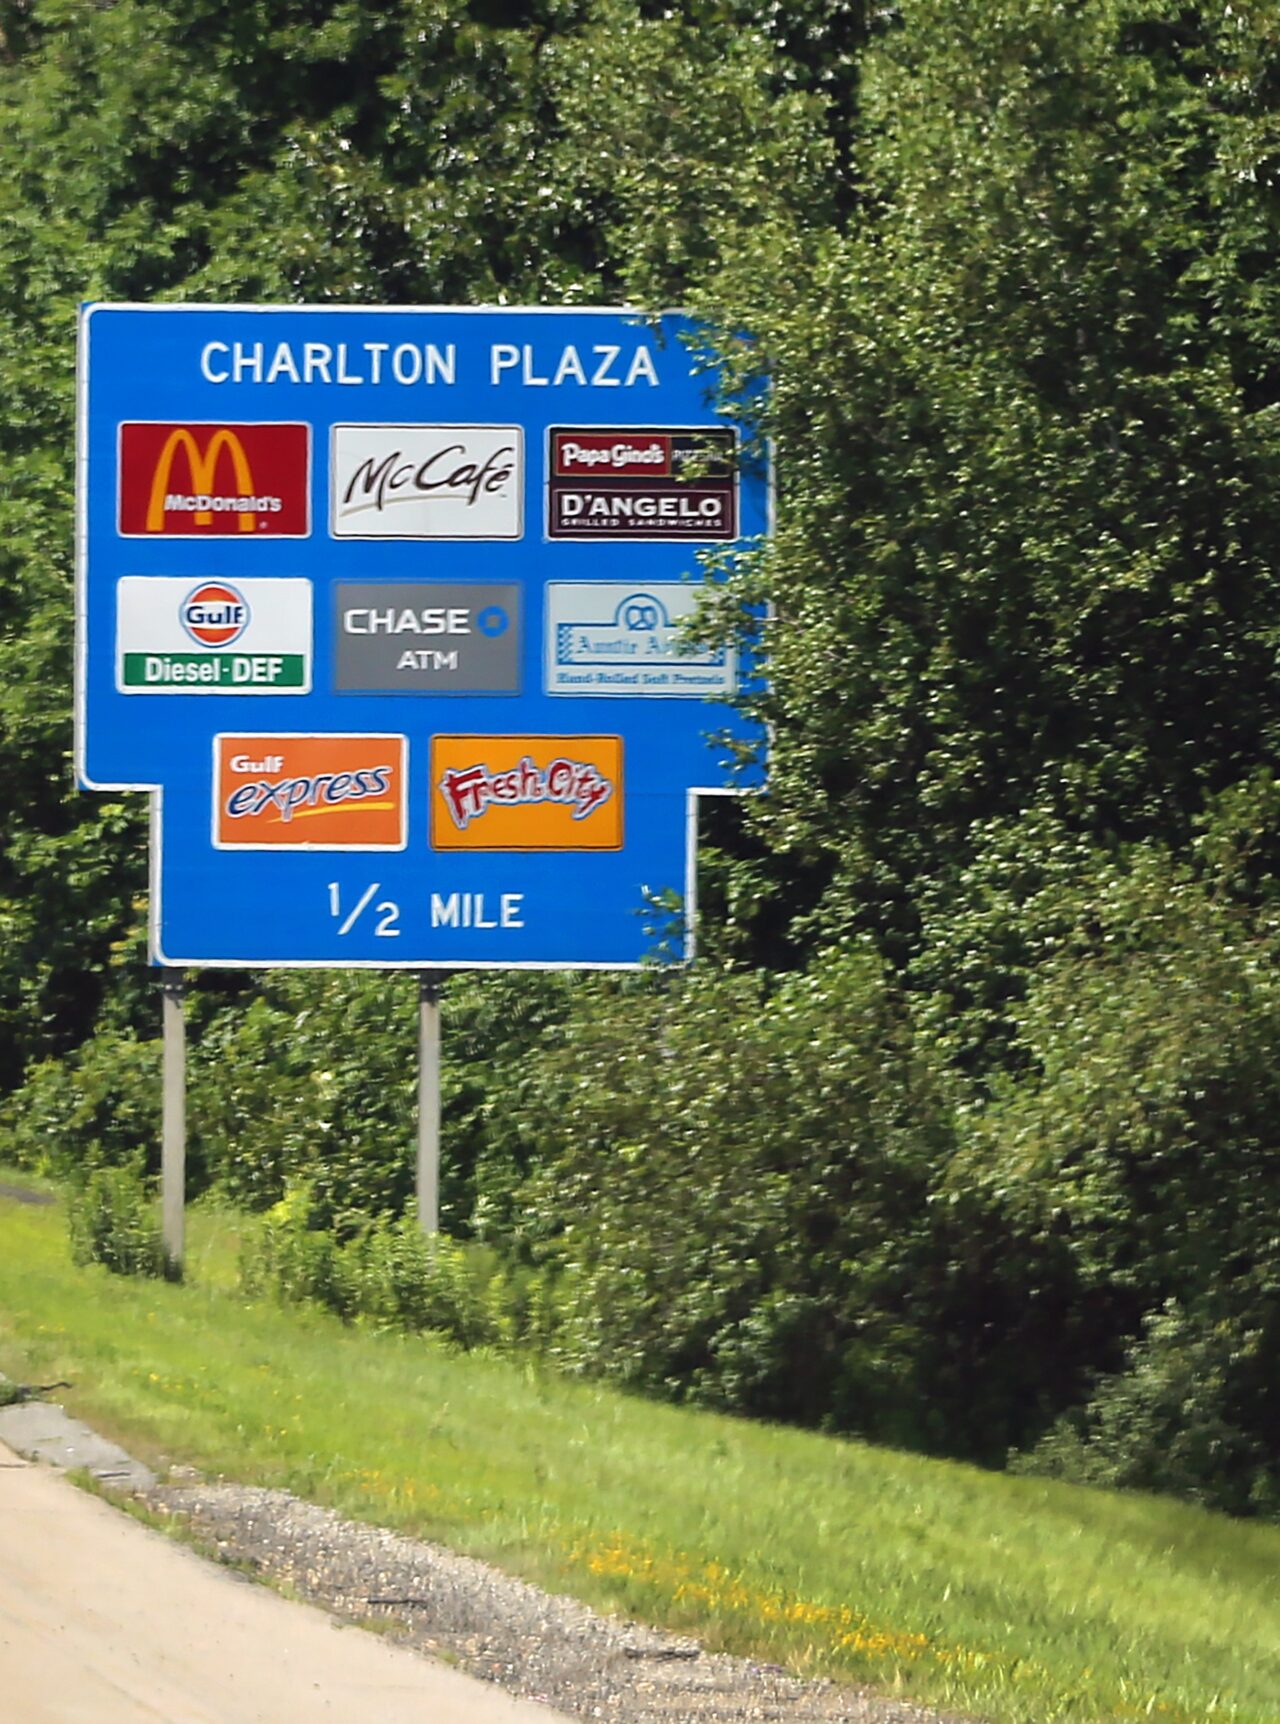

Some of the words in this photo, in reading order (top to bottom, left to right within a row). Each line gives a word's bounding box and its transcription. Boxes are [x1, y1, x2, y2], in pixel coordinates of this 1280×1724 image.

[200, 342, 457, 385] CHARLTON
[490, 344, 660, 386] PLAZA
[561, 442, 611, 467] Papa
[343, 445, 516, 512] McCafé
[164, 495, 282, 512] McDonald's
[561, 494, 722, 517] D'ANGELO
[186, 605, 244, 624] Gulf
[344, 608, 472, 635] CHASE
[396, 650, 459, 670] ATM
[229, 755, 285, 773] Gulf
[225, 765, 393, 823] express
[440, 757, 543, 829] Fresh
[547, 757, 611, 821] City
[430, 893, 525, 929] MILE
